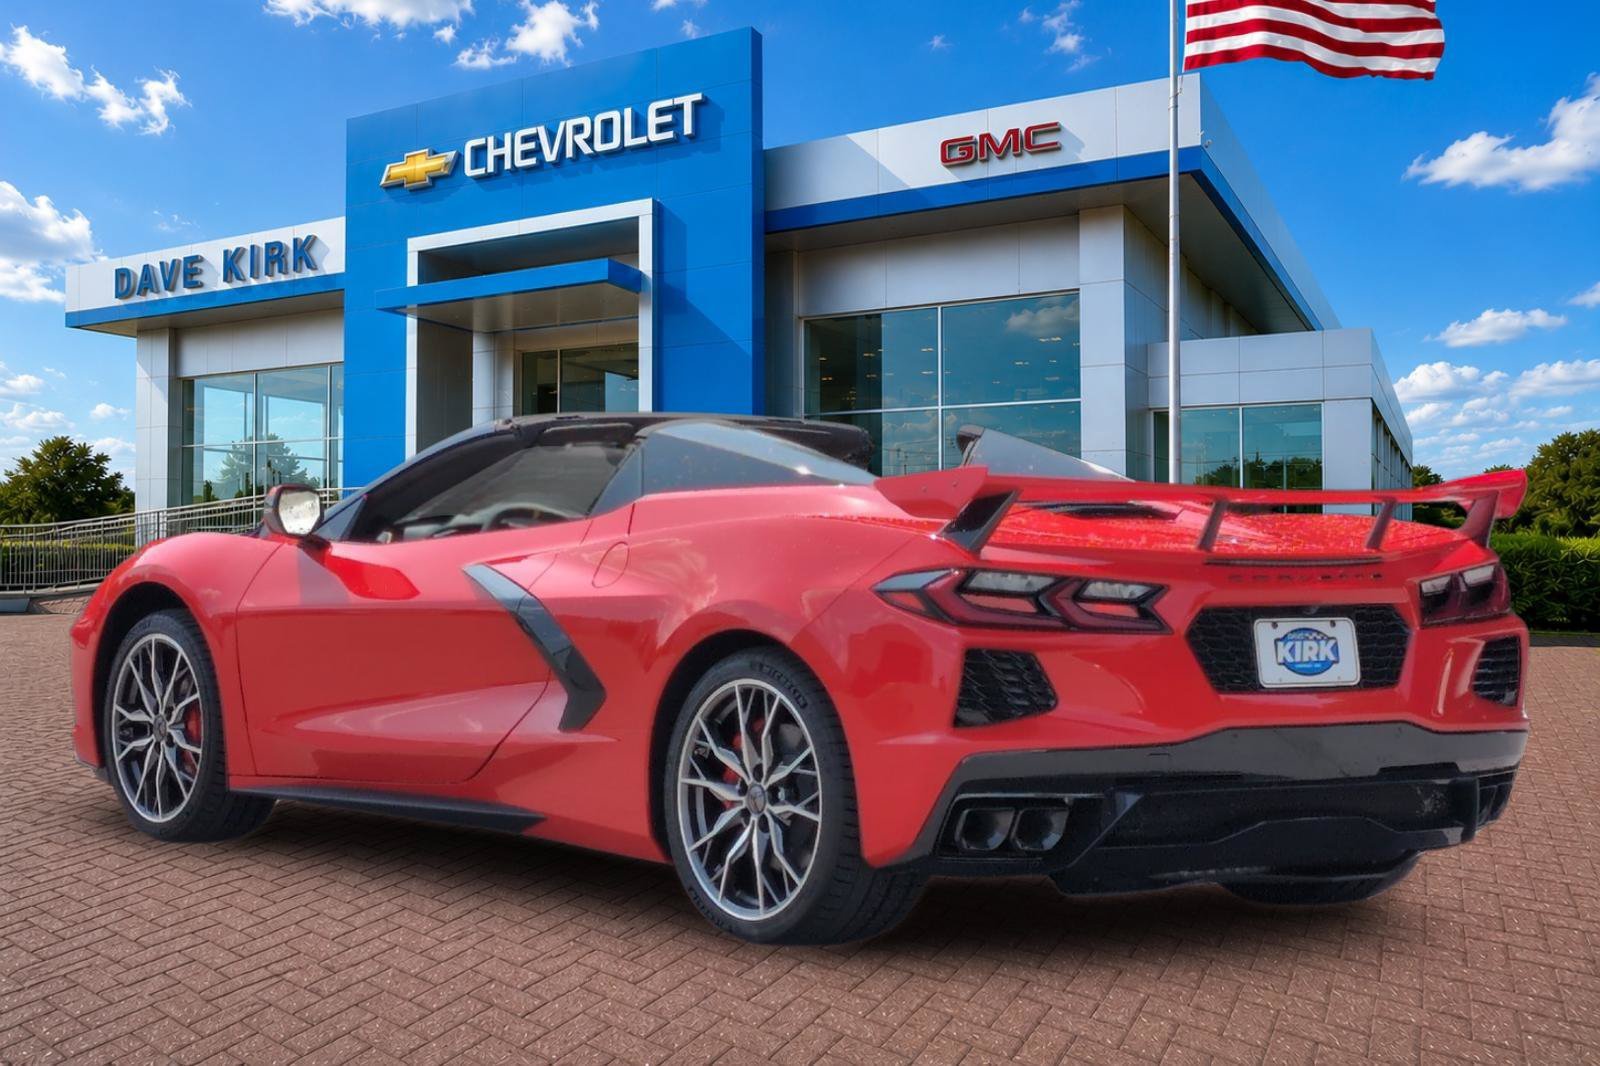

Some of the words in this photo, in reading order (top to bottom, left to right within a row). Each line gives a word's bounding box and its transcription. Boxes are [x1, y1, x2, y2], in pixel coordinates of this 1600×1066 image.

[464, 92, 703, 178] CHEVROLET
[940, 121, 1062, 166] GMC
[114, 254, 204, 300] DAVE
[222, 234, 318, 284] KIRK
[1276, 639, 1338, 663] KIRK
